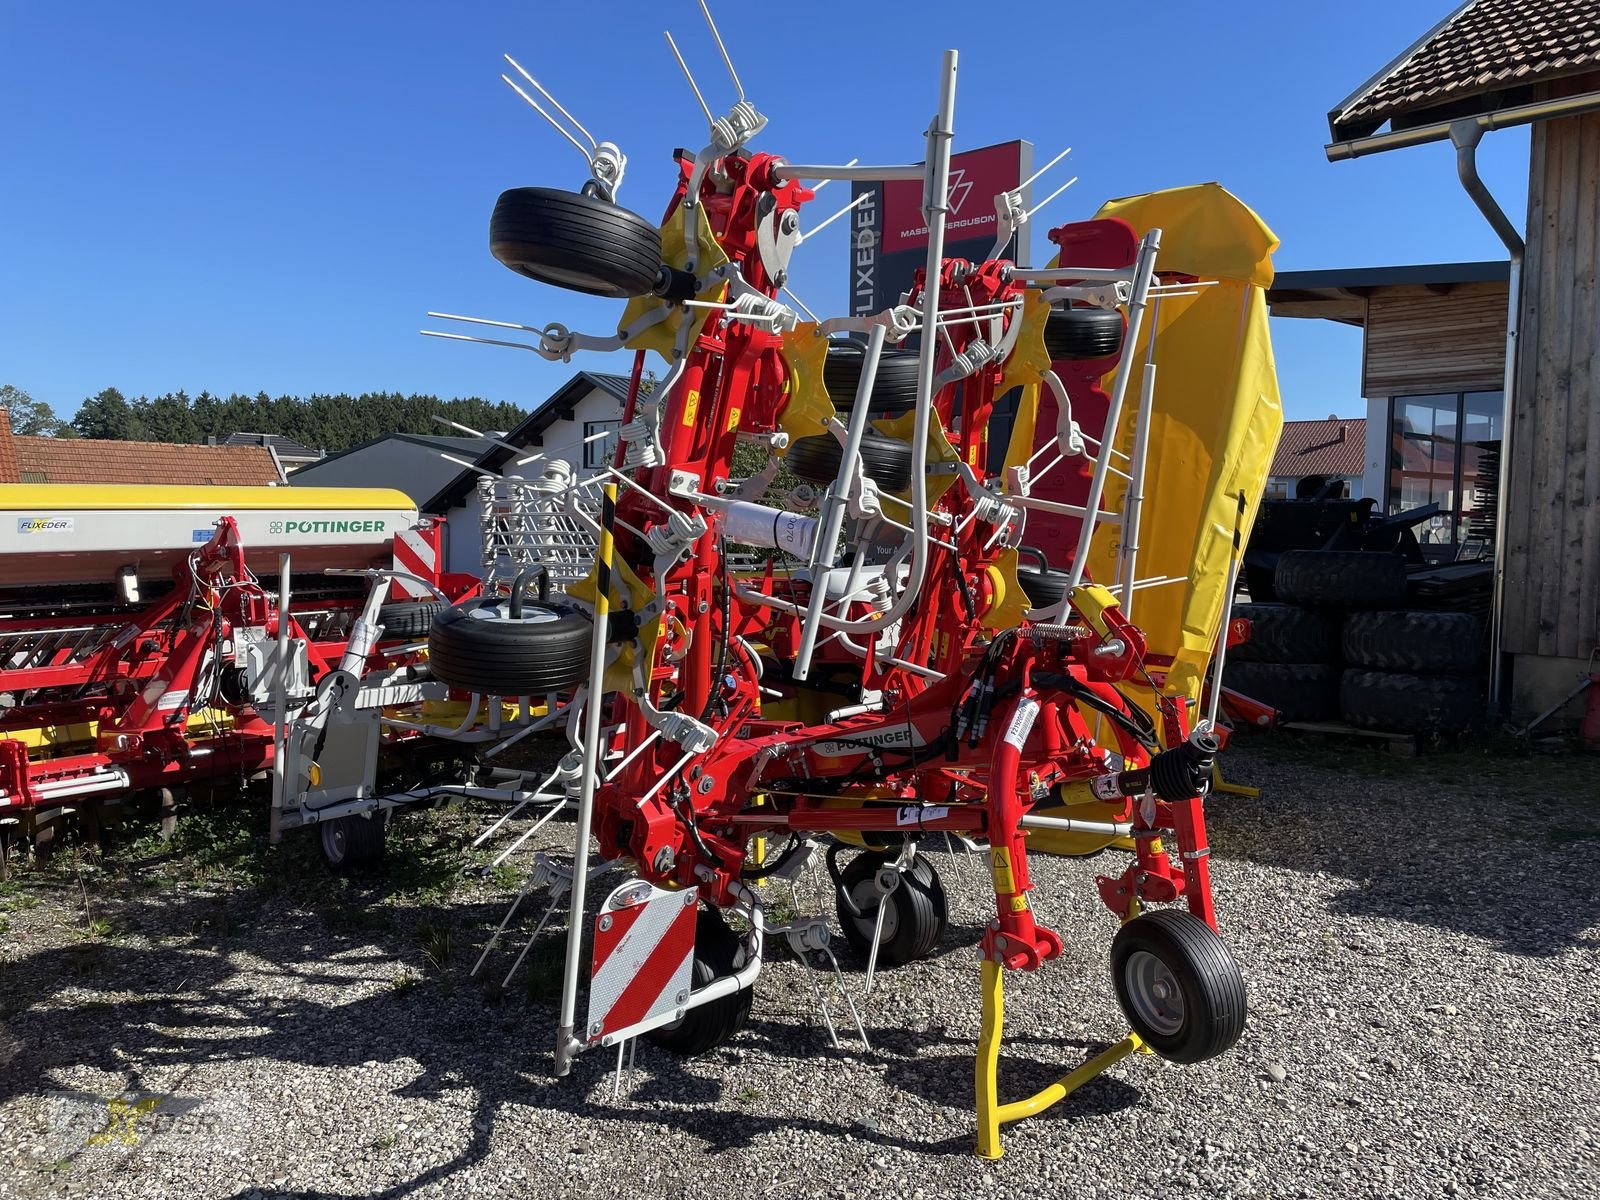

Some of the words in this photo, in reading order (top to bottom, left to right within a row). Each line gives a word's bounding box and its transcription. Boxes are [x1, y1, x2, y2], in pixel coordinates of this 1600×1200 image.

[856, 189, 876, 317] LIXEDER
[285, 520, 386, 533] PÖTTINGER
[876, 545, 892, 554] Your
